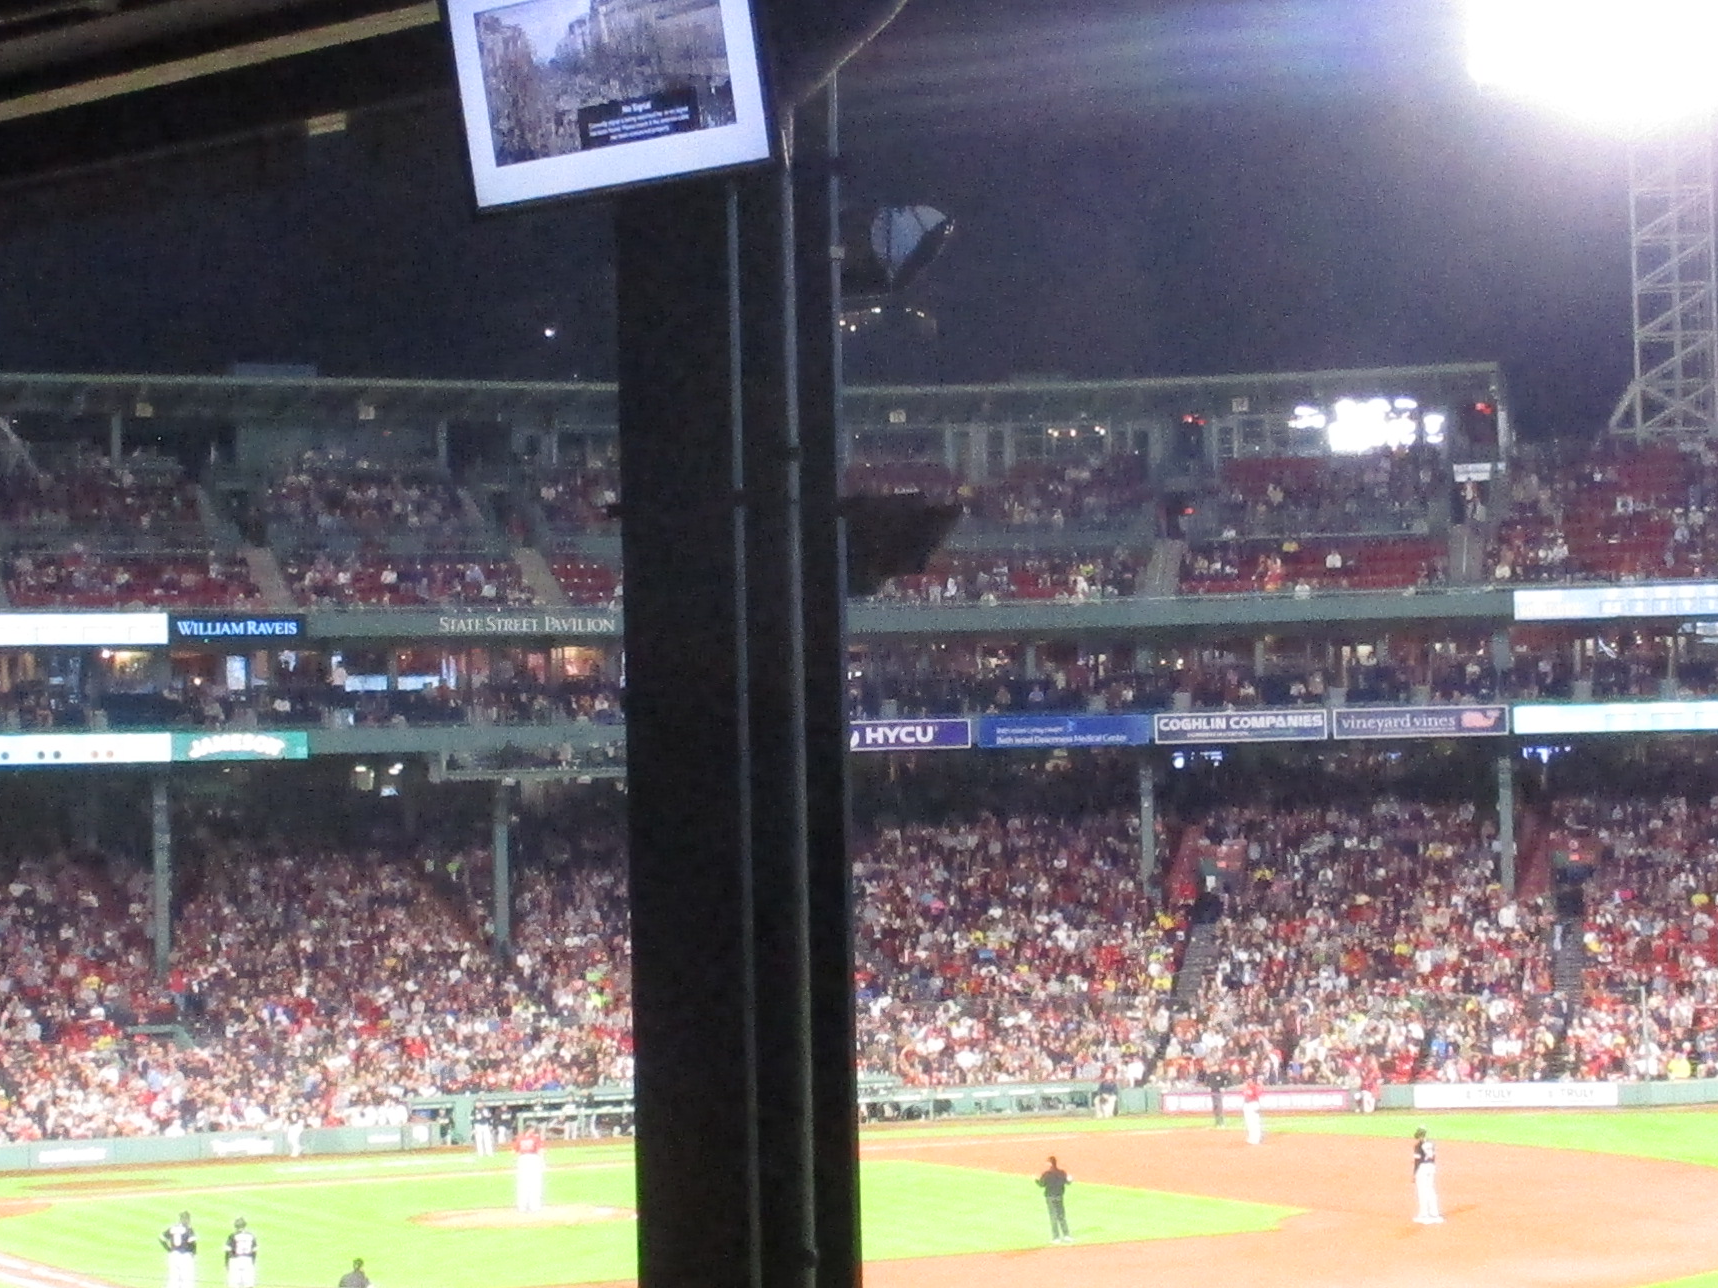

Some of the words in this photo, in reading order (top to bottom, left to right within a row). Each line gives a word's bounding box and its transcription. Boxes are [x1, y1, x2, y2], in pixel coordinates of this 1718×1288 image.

[177, 620, 244, 636] WILLIAM
[246, 620, 298, 635] RAVEIS
[439, 616, 483, 632] STATE
[486, 616, 538, 632] STREET
[544, 616, 615, 632] PAVILION
[1159, 717, 1226, 731] COGHLIN
[1229, 714, 1323, 730] COMPANIES
[1342, 716, 1411, 730] vineyard
[1412, 715, 1456, 728] vines
[865, 725, 933, 744] HYCU
[1074, 733, 1101, 743] Medical
[1103, 733, 1127, 743] Center
[1478, 1088, 1513, 1100] TRULY
[1560, 1087, 1595, 1100] TRULY
